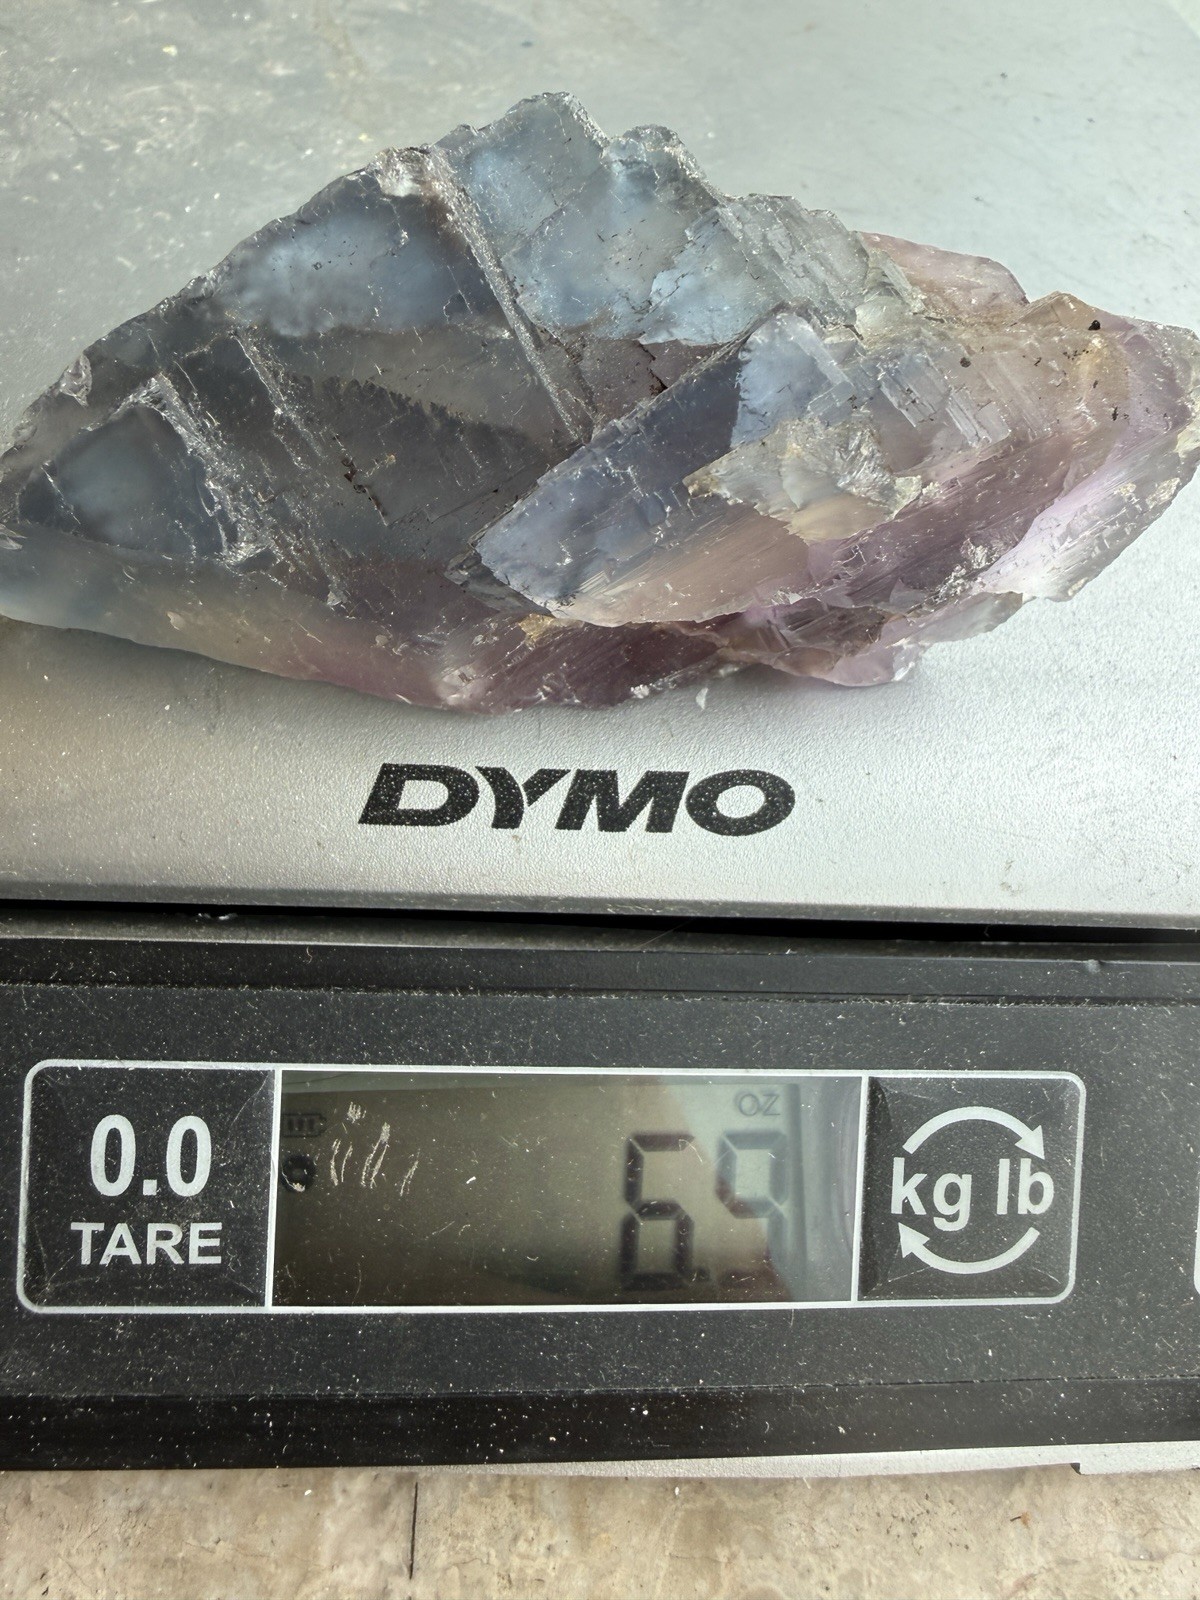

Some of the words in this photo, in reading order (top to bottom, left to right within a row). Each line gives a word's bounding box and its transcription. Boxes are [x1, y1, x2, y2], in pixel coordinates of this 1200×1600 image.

[358, 762, 795, 837] DYMO
[91, 1114, 212, 1197] 0.0
[890, 1157, 973, 1232] kg
[996, 1158, 1055, 1216] lb
[70, 1222, 223, 1266] TARE
